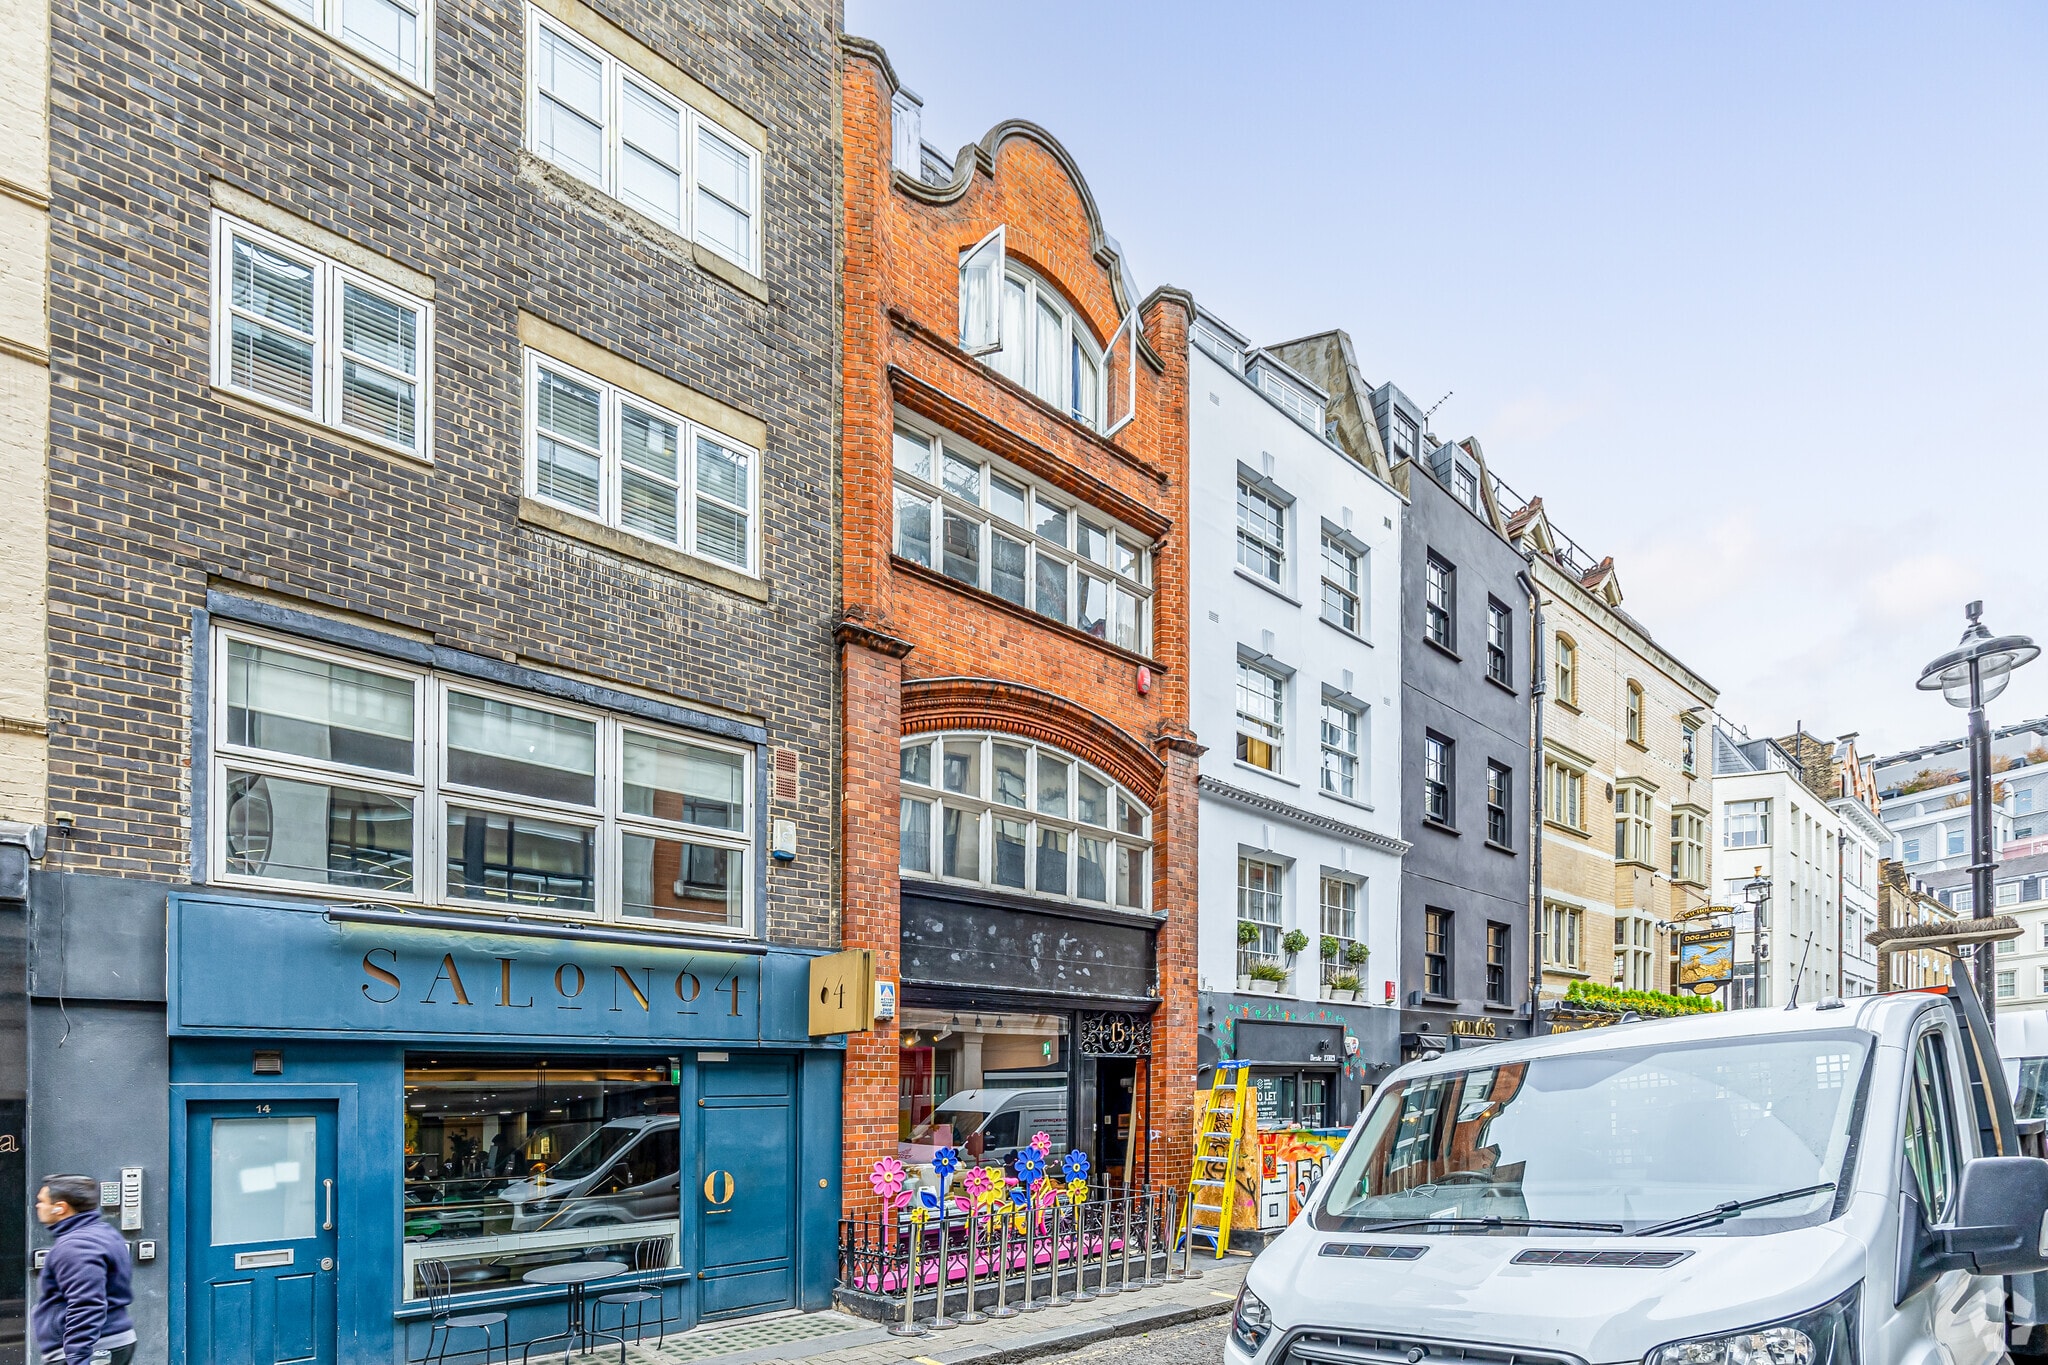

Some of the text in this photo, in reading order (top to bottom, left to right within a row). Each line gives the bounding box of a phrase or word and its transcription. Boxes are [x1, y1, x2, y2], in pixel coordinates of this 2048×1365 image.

[1684, 934, 1700, 942] DOG
[1709, 930, 1730, 939] DUCK
[820, 974, 846, 1010] 64
[1111, 1022, 1126, 1042] 15
[1256, 1091, 1277, 1102] O LET
[255, 1104, 272, 1114] 14
